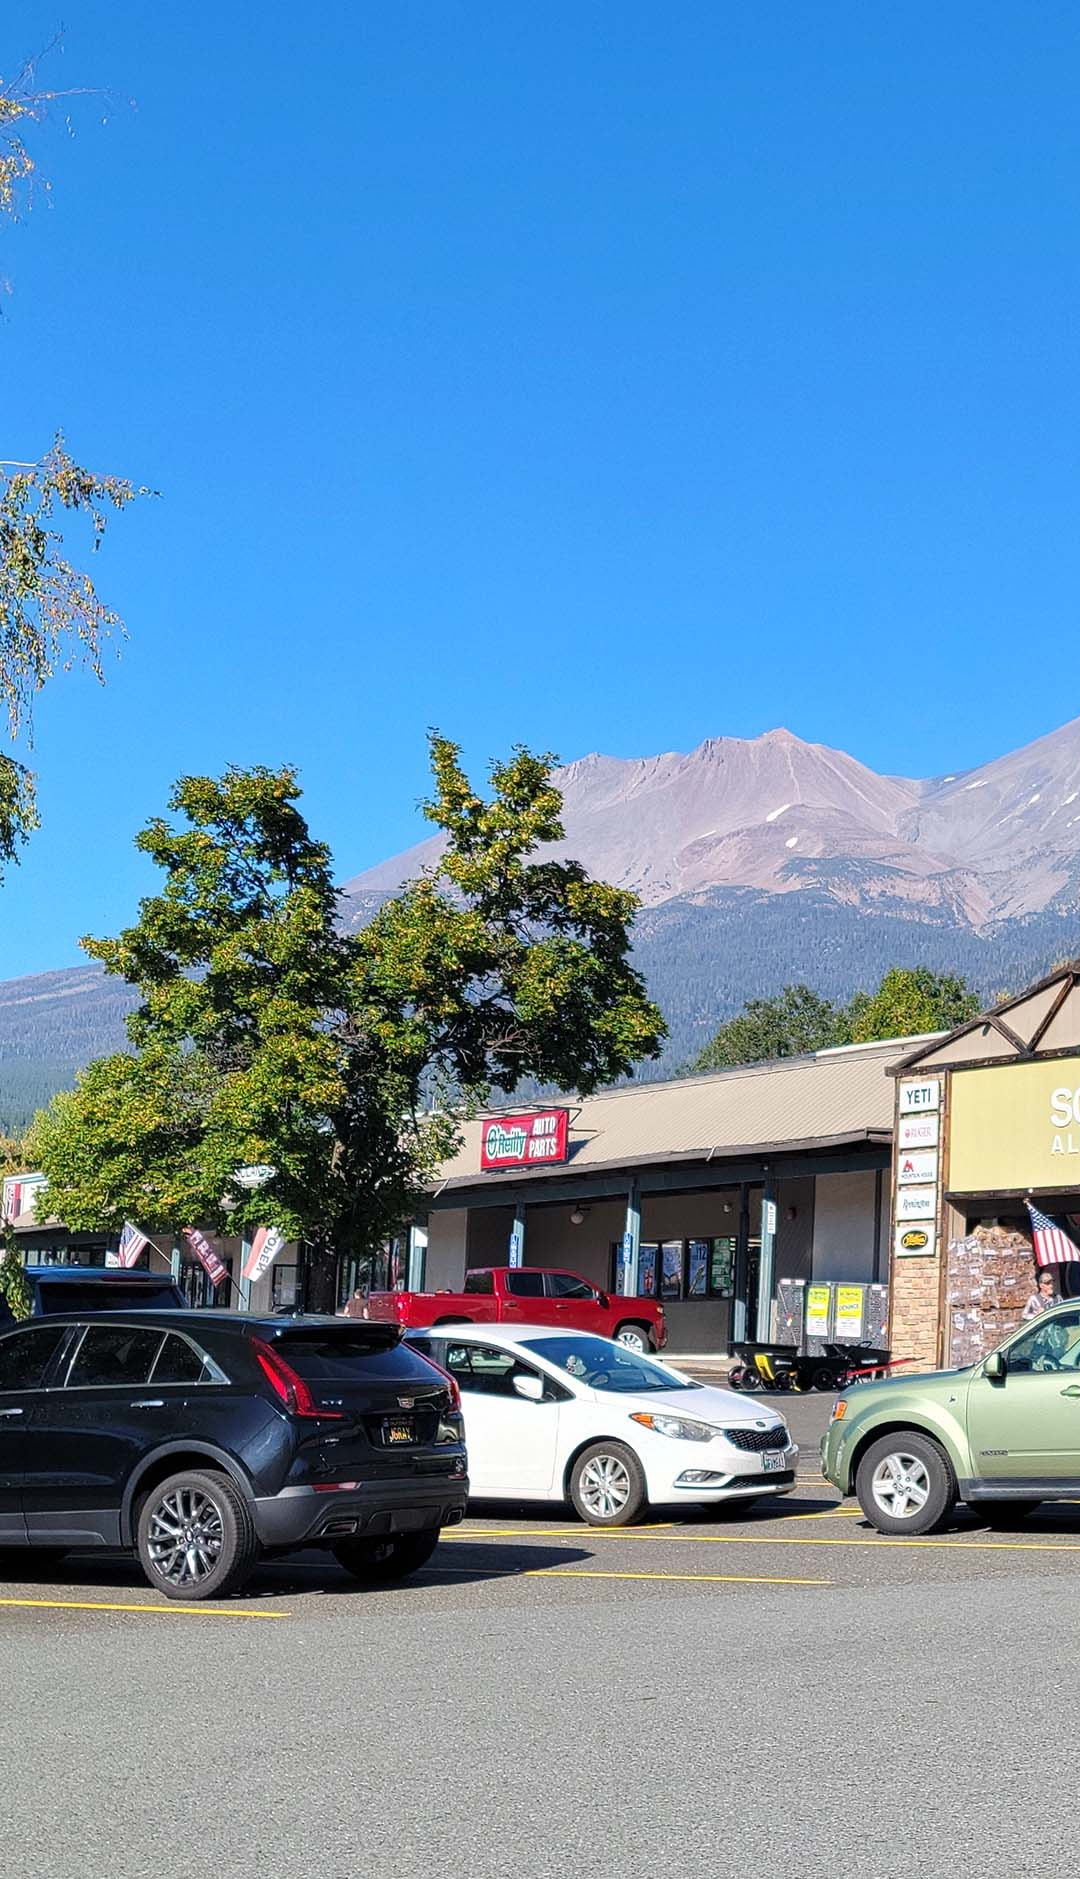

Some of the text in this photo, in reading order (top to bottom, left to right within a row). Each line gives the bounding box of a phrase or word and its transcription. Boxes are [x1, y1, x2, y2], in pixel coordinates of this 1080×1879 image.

[906, 1088, 931, 1105] YETI
[532, 1116, 556, 1136] AUTO
[487, 1124, 527, 1160] O'Reilly
[529, 1137, 556, 1158] PARTS
